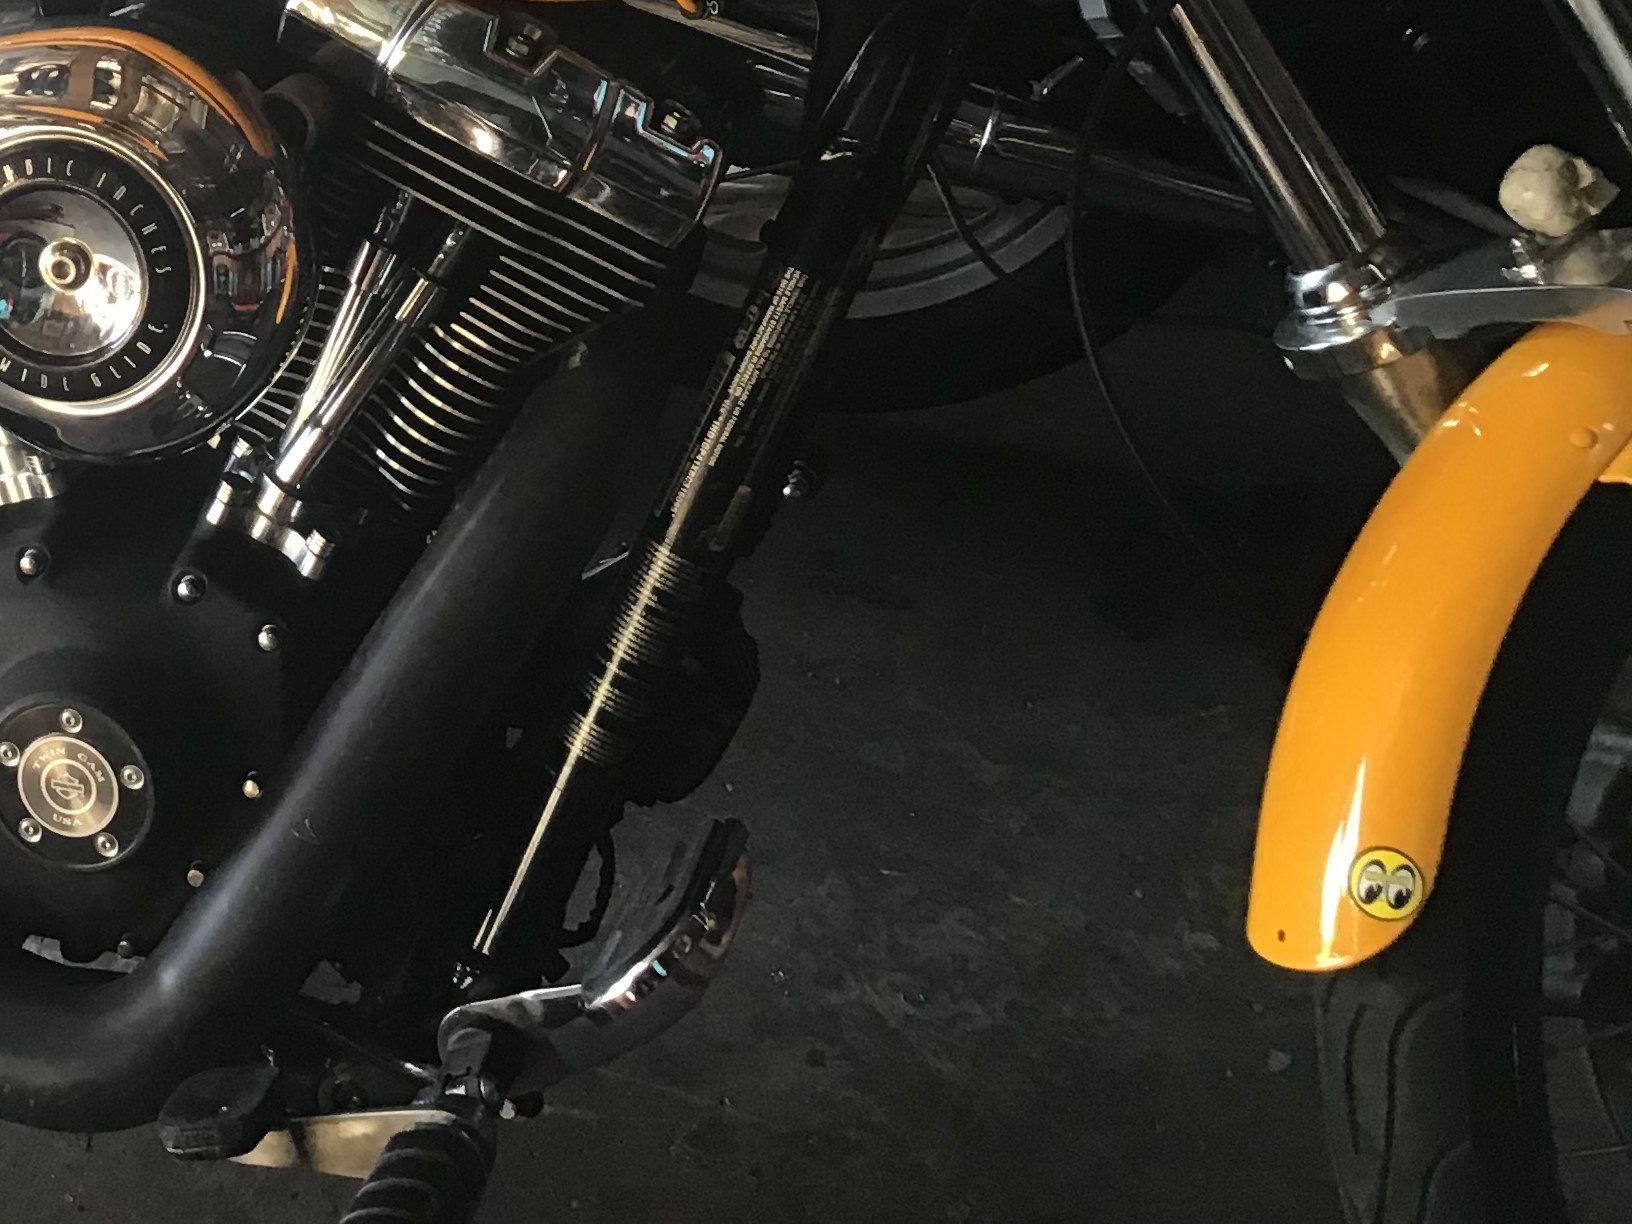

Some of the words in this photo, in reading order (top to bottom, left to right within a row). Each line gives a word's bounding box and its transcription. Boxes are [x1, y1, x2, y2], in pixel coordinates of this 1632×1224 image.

[96, 172, 172, 274] INCHES
[89, 323, 168, 388] GLIDE
[32, 746, 66, 770] TWIN
[76, 751, 106, 783] CAM
[52, 813, 83, 827] USA
